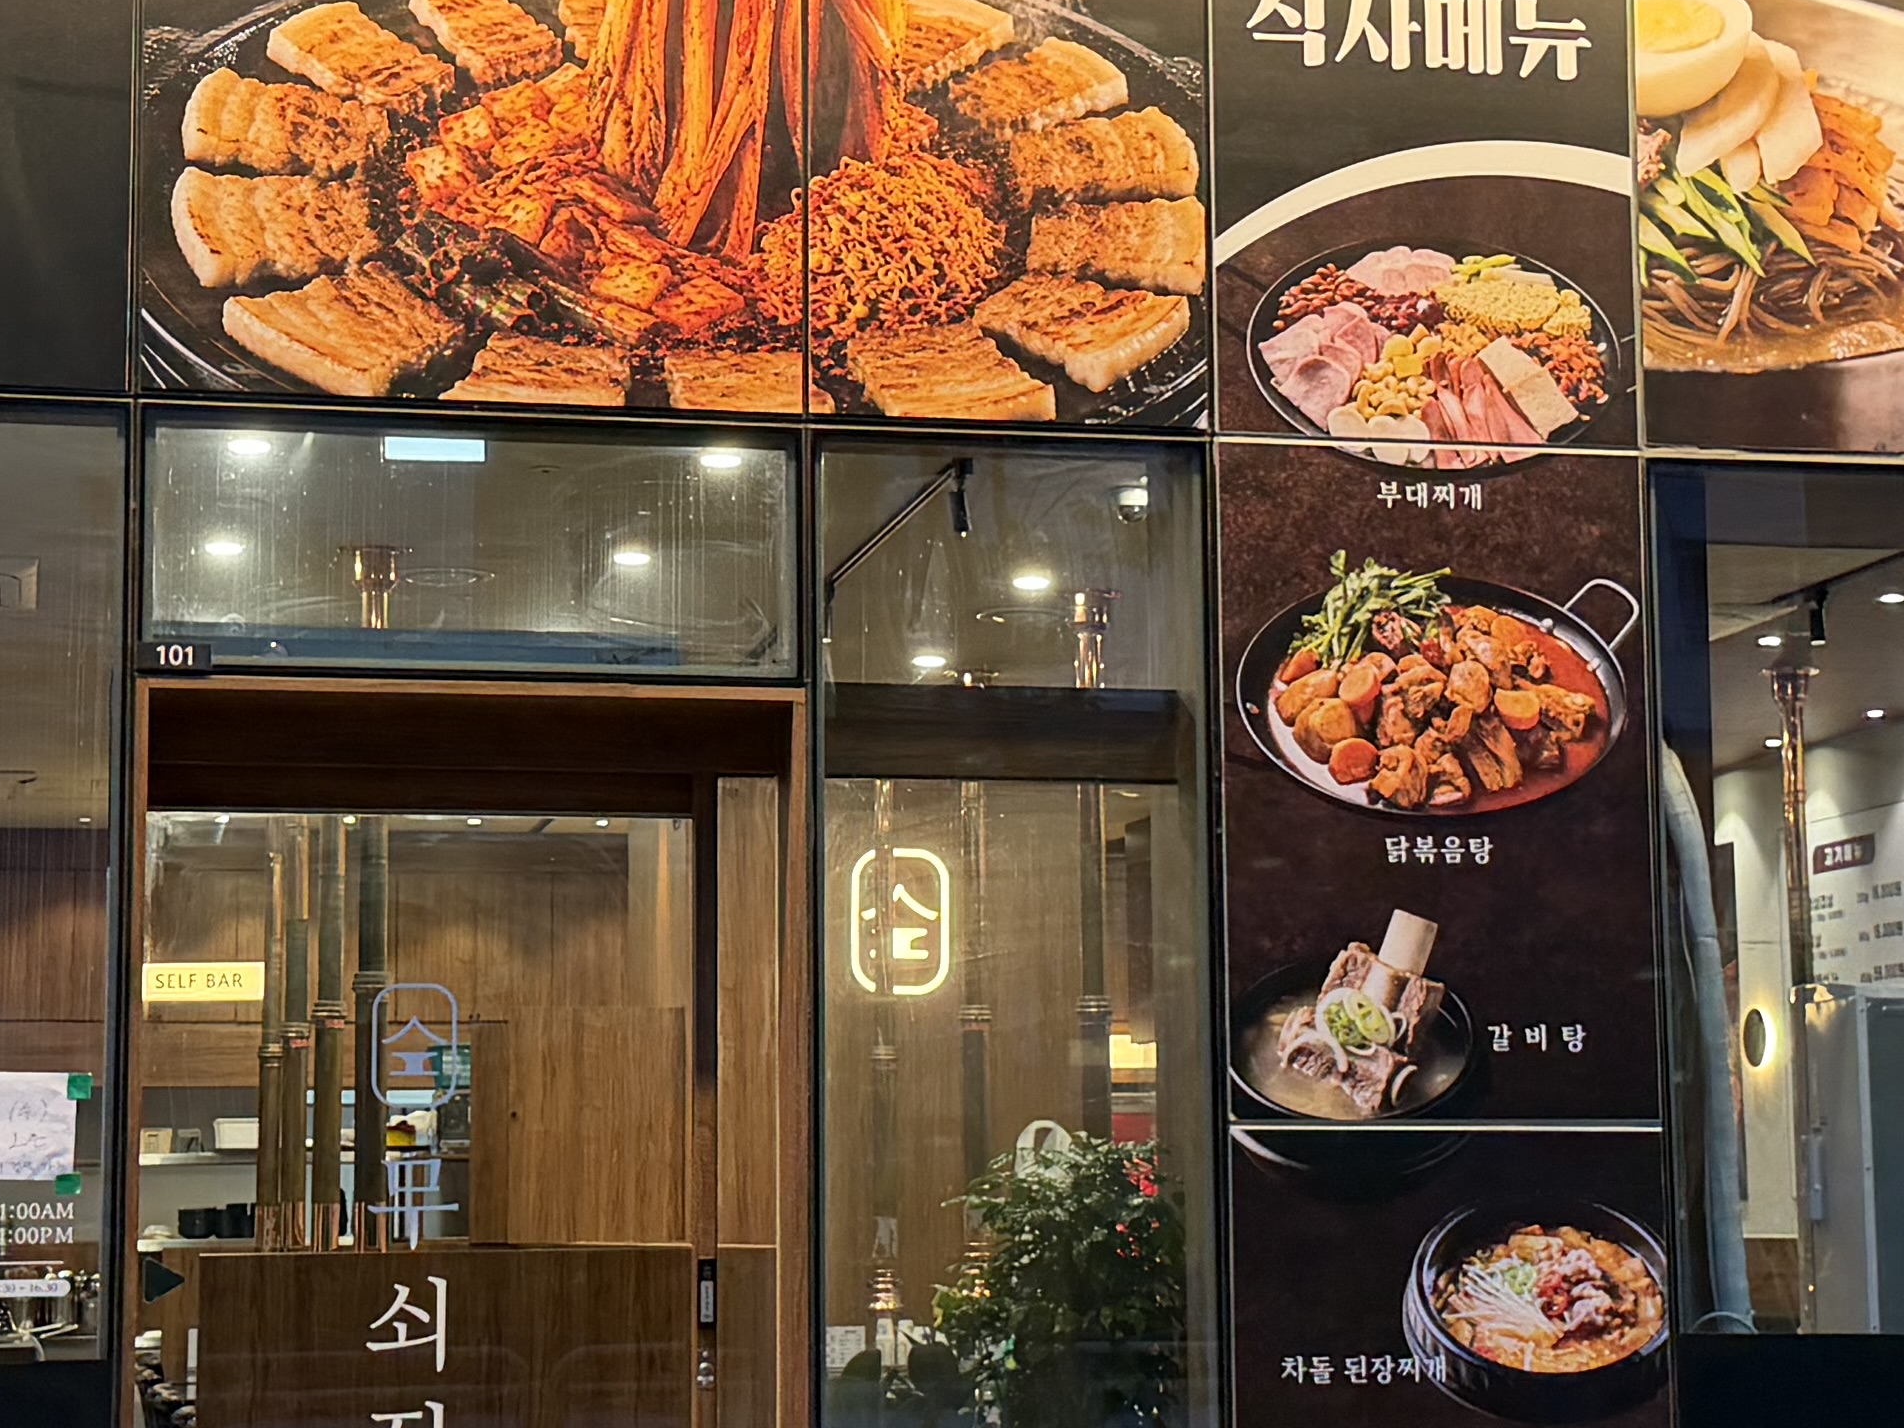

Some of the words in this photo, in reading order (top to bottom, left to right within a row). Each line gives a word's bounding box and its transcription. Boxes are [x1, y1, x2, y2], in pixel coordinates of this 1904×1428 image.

[1376, 481, 1484, 510] 부대찌개
[156, 644, 194, 666] 101
[1383, 834, 1494, 865] 닭볶음탕
[154, 973, 197, 990] SELF
[206, 972, 244, 989] BAR
[1486, 1023, 1587, 1053] 갈비탕
[1280, 1356, 1336, 1384] 차돌
[1343, 1354, 1448, 1384] 된장찌개
